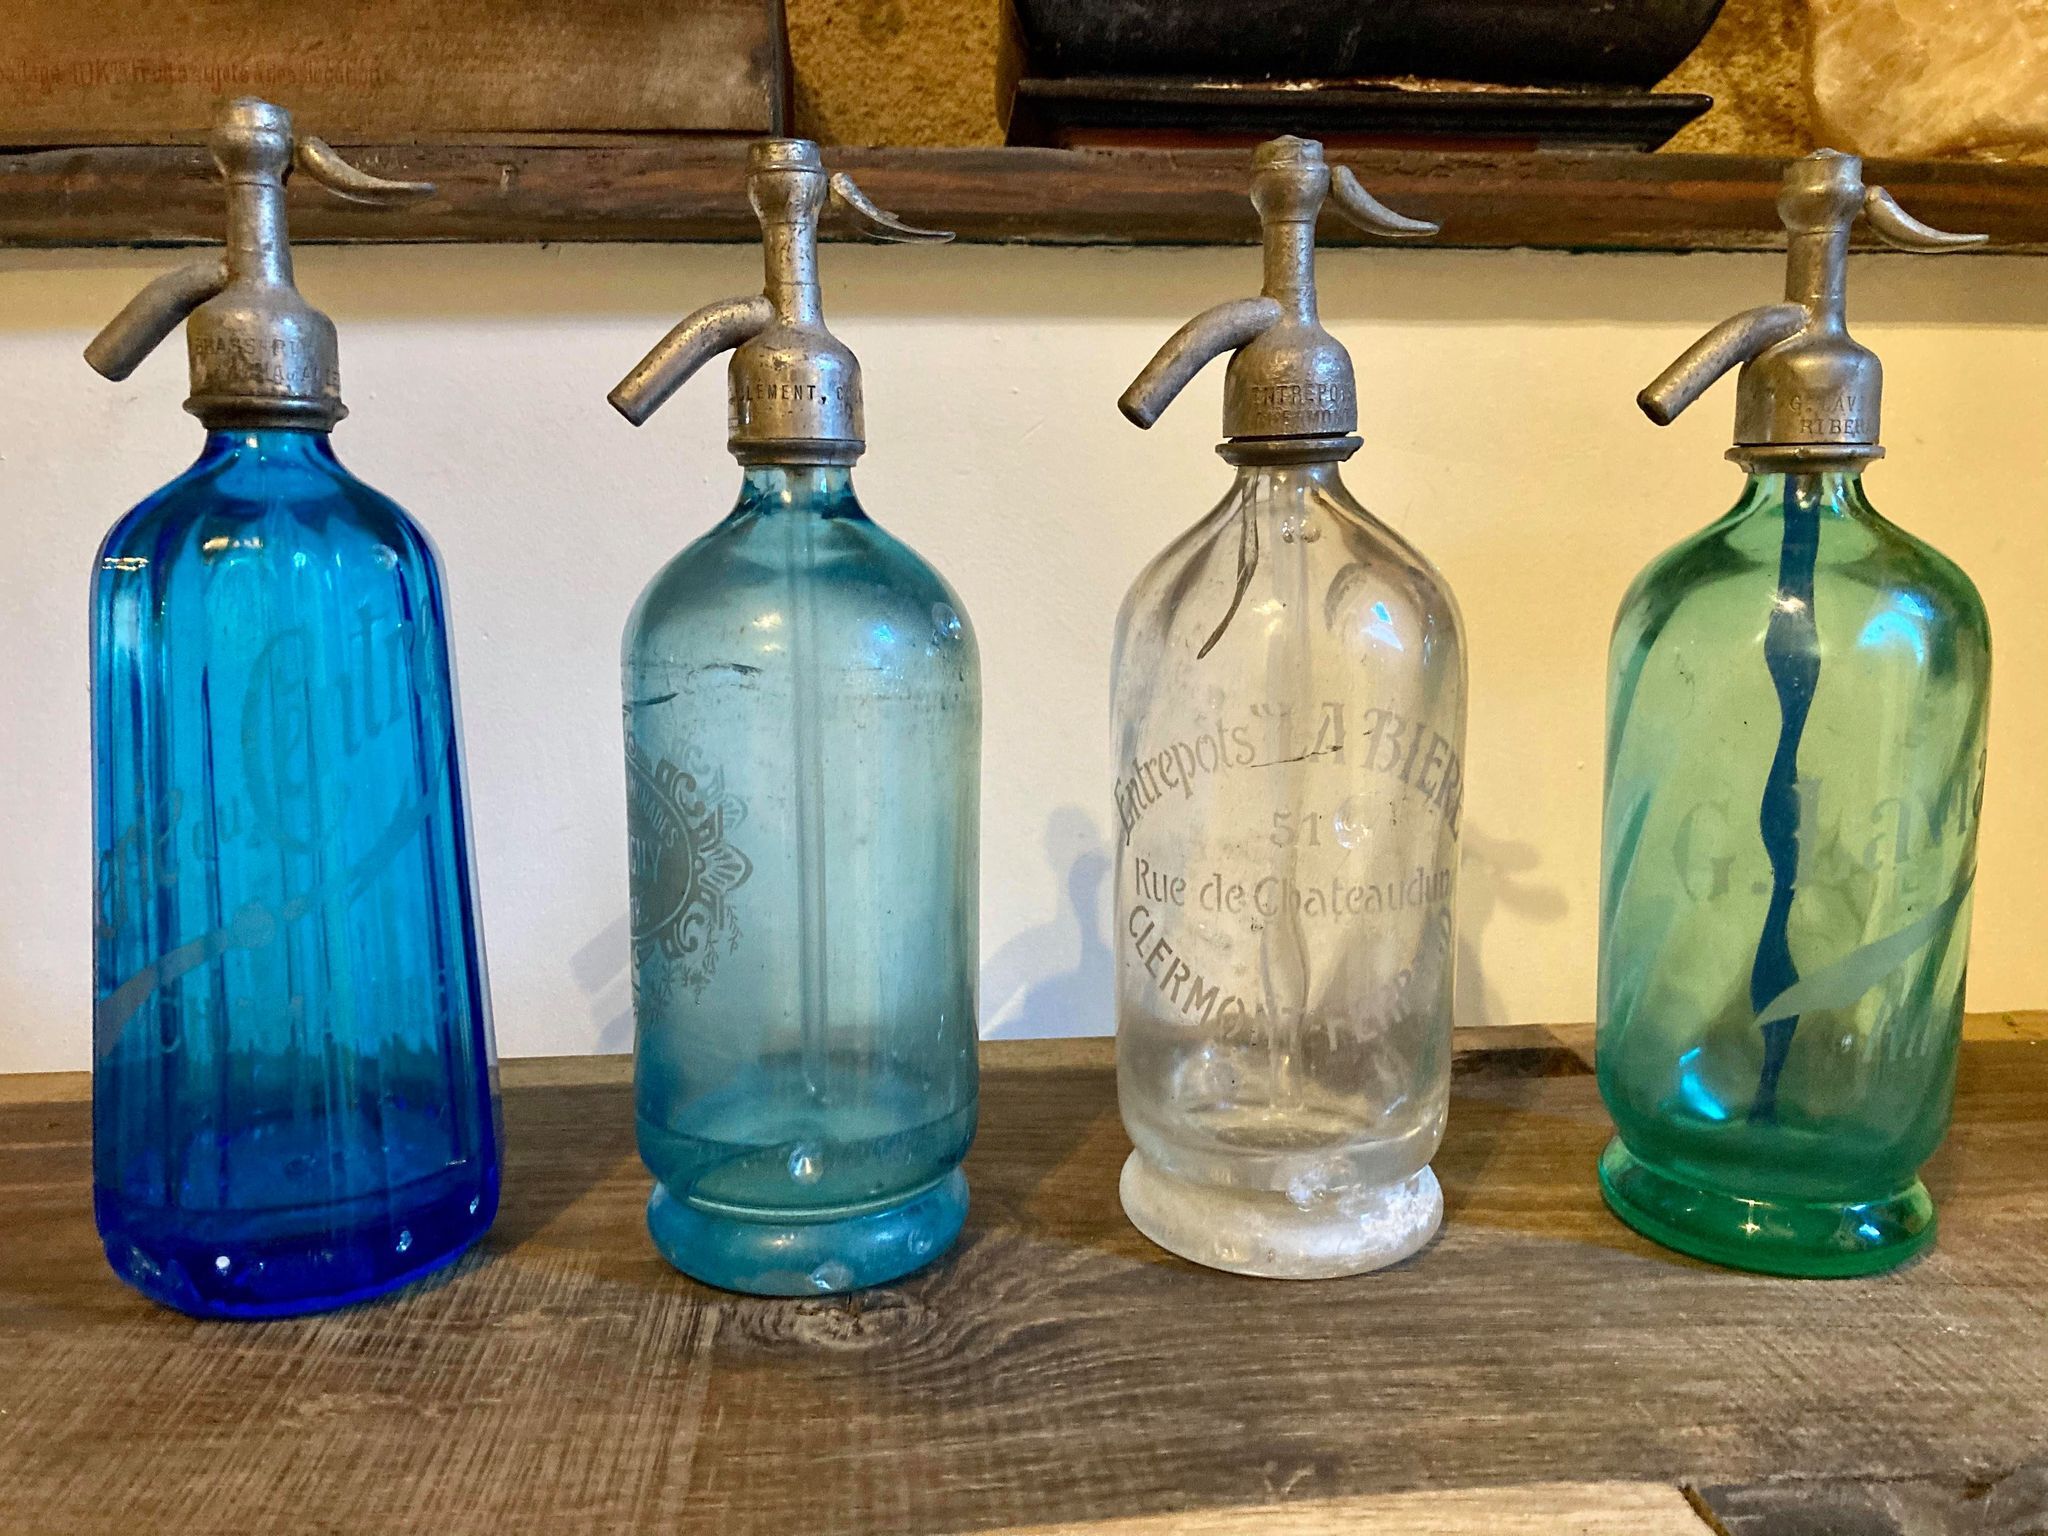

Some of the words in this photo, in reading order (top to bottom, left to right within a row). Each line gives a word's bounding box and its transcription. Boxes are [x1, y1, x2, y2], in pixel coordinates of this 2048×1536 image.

[736, 384, 828, 404] LEMENT,
[1270, 810, 1322, 848] 51
[1135, 857, 1187, 907] Rue
[1199, 872, 1244, 916] de
